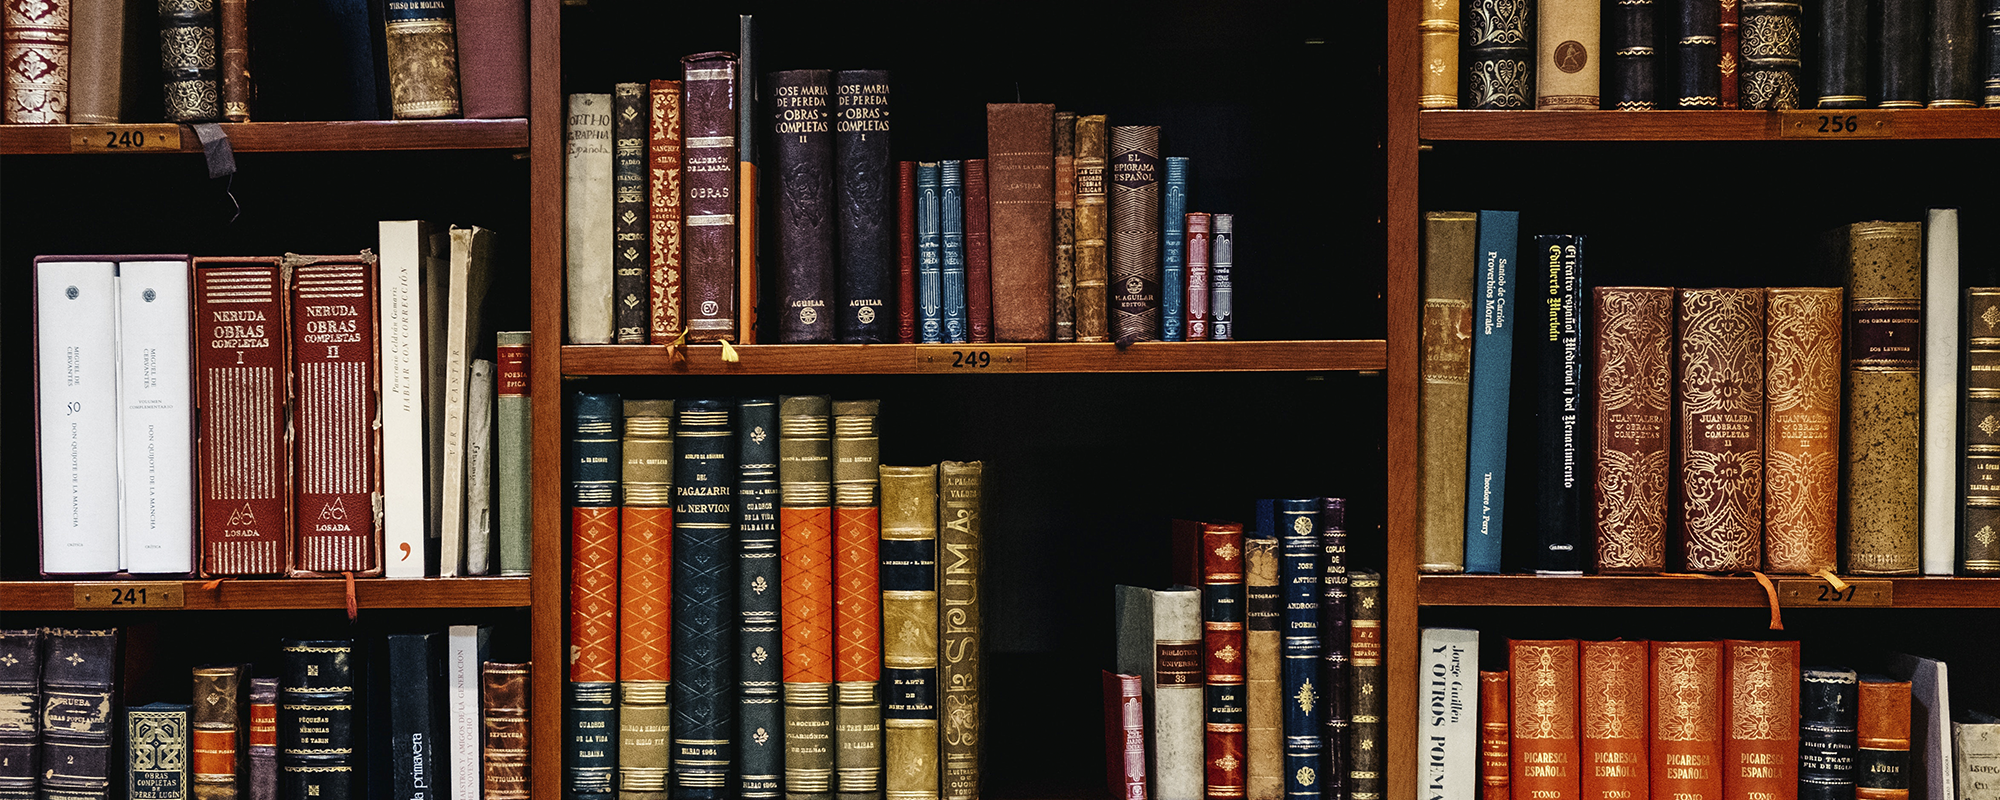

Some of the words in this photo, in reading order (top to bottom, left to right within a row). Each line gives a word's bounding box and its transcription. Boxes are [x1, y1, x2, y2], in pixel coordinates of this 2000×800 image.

[389, 2, 409, 10] TIRSO
[774, 86, 798, 96] JOSE
[800, 86, 828, 96] MARIA
[836, 84, 860, 95] JOSE
[862, 84, 890, 94] MARIA
[777, 97, 788, 108] DE
[791, 97, 826, 107] PEREDA
[839, 96, 850, 106] DE
[852, 95, 888, 106] PEREDA
[784, 109, 819, 121] OBRAS
[846, 108, 880, 119] OBRAS
[775, 121, 828, 134] COMPLETAS
[836, 120, 890, 132] COMPLETAS
[1817, 115, 1858, 133] 256
[106, 130, 144, 148] 240
[800, 136, 808, 144] II
[688, 156, 729, 164] CALDERÓN
[1128, 154, 1140, 162] EL
[1114, 163, 1155, 172] EPIGRAMA
[1114, 171, 1154, 182] ESPAÑOL
[690, 187, 730, 198] OBRAS
[1565, 244, 1577, 259] El
[1486, 250, 1498, 300] Proverbios
[1498, 258, 1508, 290] Santob
[1564, 260, 1576, 292] teatro
[1497, 289, 1506, 298] de
[398, 266, 409, 341] CORRECCIÓN
[792, 300, 825, 308] AGUILAR
[850, 299, 883, 307] AGUILAR
[212, 310, 266, 323] NERUDA
[306, 305, 359, 317] NERUDA
[1496, 298, 1506, 329] Carrión
[1563, 294, 1576, 334] español
[1484, 300, 1495, 336] Morales
[213, 324, 265, 339] OBRAS
[306, 320, 356, 334] OBRAS
[212, 338, 270, 348] COMPLETAS
[304, 332, 362, 343] COMPLETAS
[236, 351, 245, 364] I
[326, 345, 340, 358] II
[402, 342, 410, 364] CON
[952, 350, 991, 369] 249
[1562, 337, 1576, 386] Medieval
[450, 350, 460, 404] CANTAR
[402, 368, 411, 412] HABLAR
[66, 402, 82, 416] 50
[1564, 397, 1576, 412] del
[1610, 414, 1632, 422] JUAN
[1634, 414, 1664, 424] VALERA
[1700, 414, 1722, 422] JUAN
[1724, 414, 1753, 422] VALERA
[1776, 414, 1800, 423] JUAN
[1800, 414, 1831, 424] VALERA
[1614, 430, 1660, 438] COMPLETAS
[1782, 431, 1828, 439] COMPLETAS
[450, 432, 458, 456] VER
[1800, 440, 1810, 448] III
[70, 441, 78, 472] QUIJOTE
[1562, 414, 1576, 489] Renacimiento
[72, 473, 78, 483] DE
[72, 484, 78, 494] LA
[677, 486, 730, 496] PAGAZARRI
[1483, 472, 1492, 505] Theodore
[676, 504, 686, 513] AL
[688, 504, 730, 514] NERVION
[746, 502, 772, 510] CUADROS
[1482, 506, 1491, 515] A.
[224, 529, 260, 538] LOSADA
[316, 524, 351, 532] LOSADA
[1326, 546, 1346, 554] COPLAS
[1332, 556, 1340, 564] DE
[1326, 566, 1346, 574] MINGO
[111, 588, 147, 605] 241
[1817, 585, 1857, 602] 257
[1432, 644, 1447, 657] Y
[1162, 660, 1198, 668] UNIVERSAL
[1450, 644, 1464, 678] Jorge
[1174, 675, 1186, 684] 33
[1431, 663, 1447, 728] OTROS
[1450, 680, 1464, 724] Guillén
[1212, 706, 1243, 714] PUEBLOS
[298, 716, 330, 724] PEQUEÑAS
[67, 754, 74, 764] 2
[579, 750, 605, 758] BILBAINA
[1524, 752, 1568, 764] PICARESCA
[1594, 752, 1638, 764] PICARESCA
[1666, 754, 1710, 766] PICARESCA
[1740, 752, 1785, 765] PICARESCA
[3, 757, 9, 766] 1
[410, 732, 428, 789] primavera
[1524, 764, 1567, 777] ESPAÑOLA
[1595, 764, 1637, 777] ESPAÑOLA
[1667, 766, 1709, 780] ESPAÑOLA
[1741, 766, 1783, 778] ESPAÑOLA
[1531, 790, 1561, 799] TOMO
[1602, 790, 1631, 799] TOMO
[1748, 792, 1777, 800] TOMO
